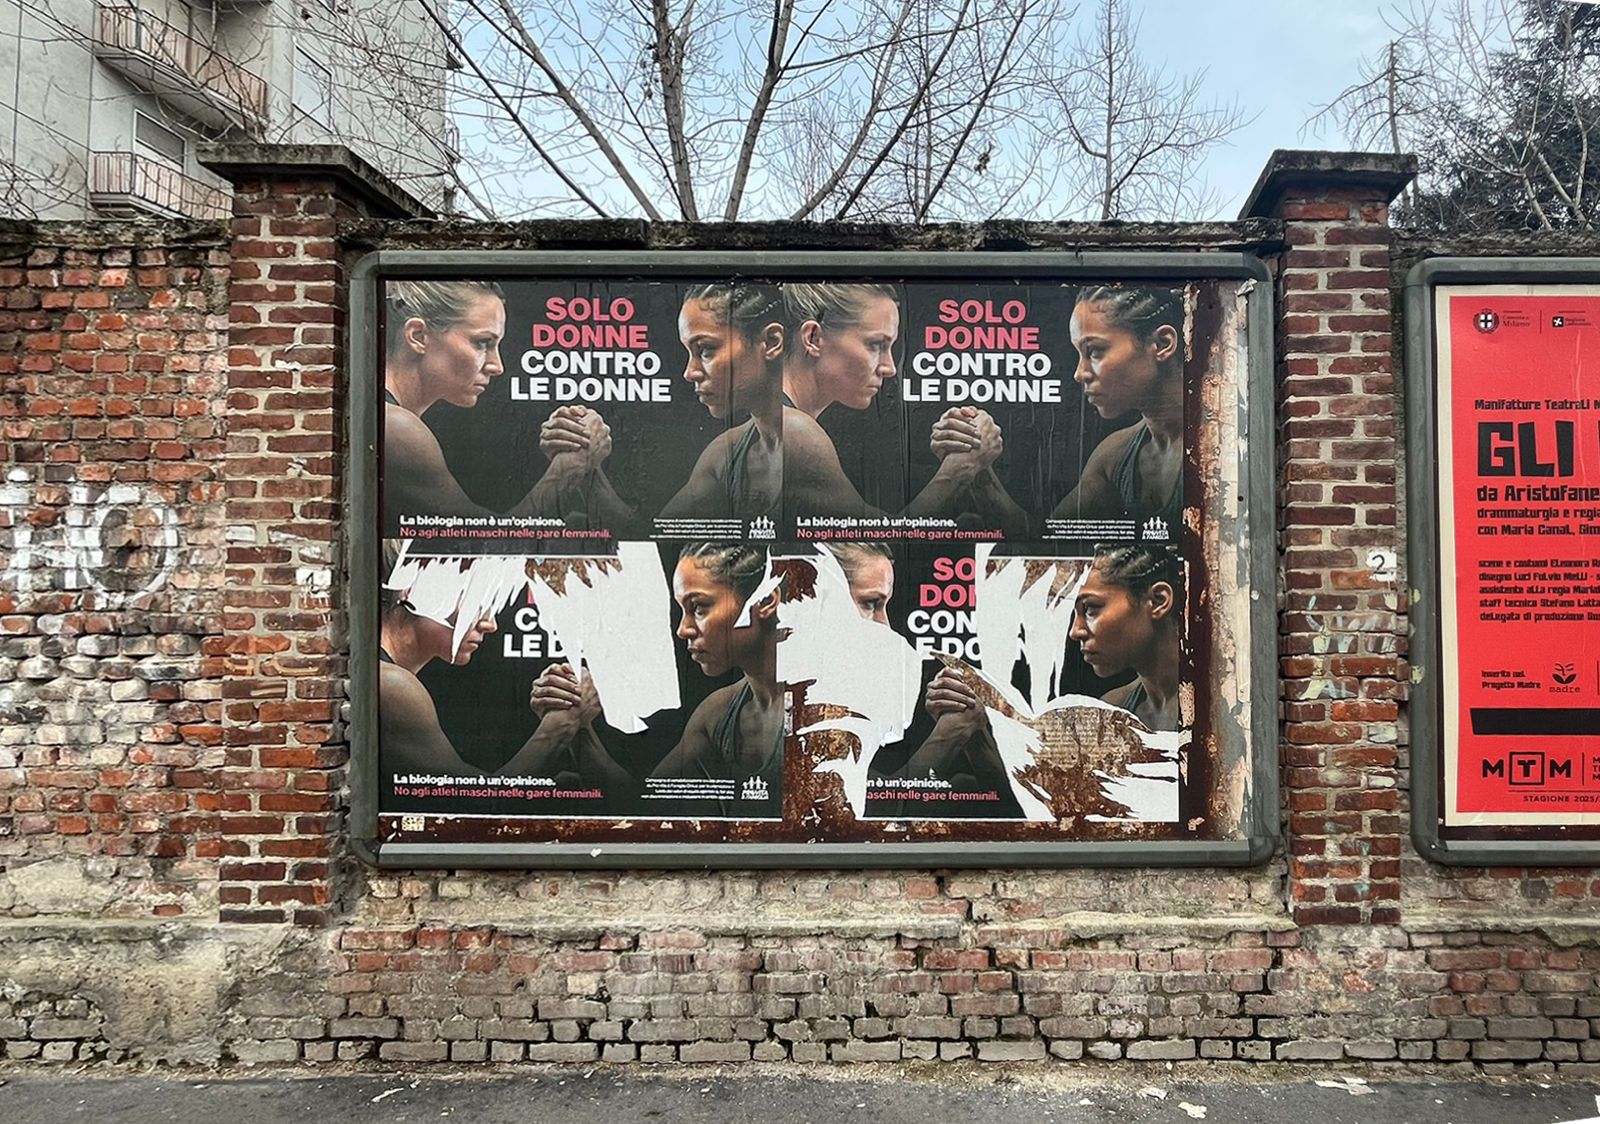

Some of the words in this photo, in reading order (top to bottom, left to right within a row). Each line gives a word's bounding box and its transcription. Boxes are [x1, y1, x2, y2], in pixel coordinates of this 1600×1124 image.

[546, 297, 635, 322] SOLO
[938, 299, 1026, 324] SOLO
[533, 324, 649, 349] DONNE
[925, 326, 1040, 350] DONNE
[521, 350, 661, 376] CONTRO
[912, 352, 1052, 377] CONTRO
[511, 377, 550, 401] LE
[555, 377, 672, 402] DONNE
[903, 378, 941, 402] LE
[946, 378, 1062, 403] DONNE
[1475, 399, 1541, 410] Manifatture
[1477, 420, 1574, 477] GLI
[1477, 485, 1498, 501] da
[1504, 484, 1600, 501] Aristofane
[400, 515, 416, 526] La
[416, 515, 463, 528] biologia
[465, 518, 488, 526] non
[489, 516, 496, 526] è
[498, 516, 566, 528] un'opinione.
[797, 516, 811, 527] La
[812, 516, 858, 529] biologia
[859, 519, 882, 527] non
[882, 517, 890, 527] è
[891, 517, 957, 529] un'opinione.
[1477, 507, 1559, 521] drammaturgia
[1563, 508, 1570, 518] e
[400, 527, 417, 537] No
[418, 527, 438, 539] agli
[439, 528, 467, 538] atleti
[469, 528, 508, 538] maschi
[509, 528, 535, 538] nelle
[536, 530, 560, 540] gare
[562, 528, 611, 538] femminili.
[797, 529, 813, 538] No
[814, 529, 833, 540] agli
[834, 529, 861, 538] atleti
[863, 529, 901, 539] maschi
[902, 529, 927, 539] nelle
[928, 531, 952, 540] gare
[954, 529, 1004, 539] femminili.
[1477, 525, 1498, 535] con
[1501, 524, 1534, 535] Maria
[933, 557, 976, 581] SO
[1372, 555, 1386, 575] 2
[907, 610, 977, 634] CON
[503, 634, 543, 658] LE
[1549, 685, 1581, 693] madre
[394, 774, 408, 784] La
[409, 774, 454, 786] biologia
[455, 777, 477, 785] non
[478, 775, 486, 785] è
[487, 776, 556, 787] un'opinione.
[876, 778, 883, 788] è
[884, 778, 952, 790] un'opinione.
[394, 786, 409, 796] No
[411, 786, 430, 798] agli
[431, 787, 458, 797] atleti
[459, 787, 498, 797] maschi
[499, 787, 525, 798] nelle
[526, 789, 550, 799] gare
[552, 787, 603, 798] femminili.
[866, 790, 895, 800] aschi
[897, 790, 920, 800] nelle
[923, 792, 945, 802] gare
[948, 790, 1000, 801] femminili.
